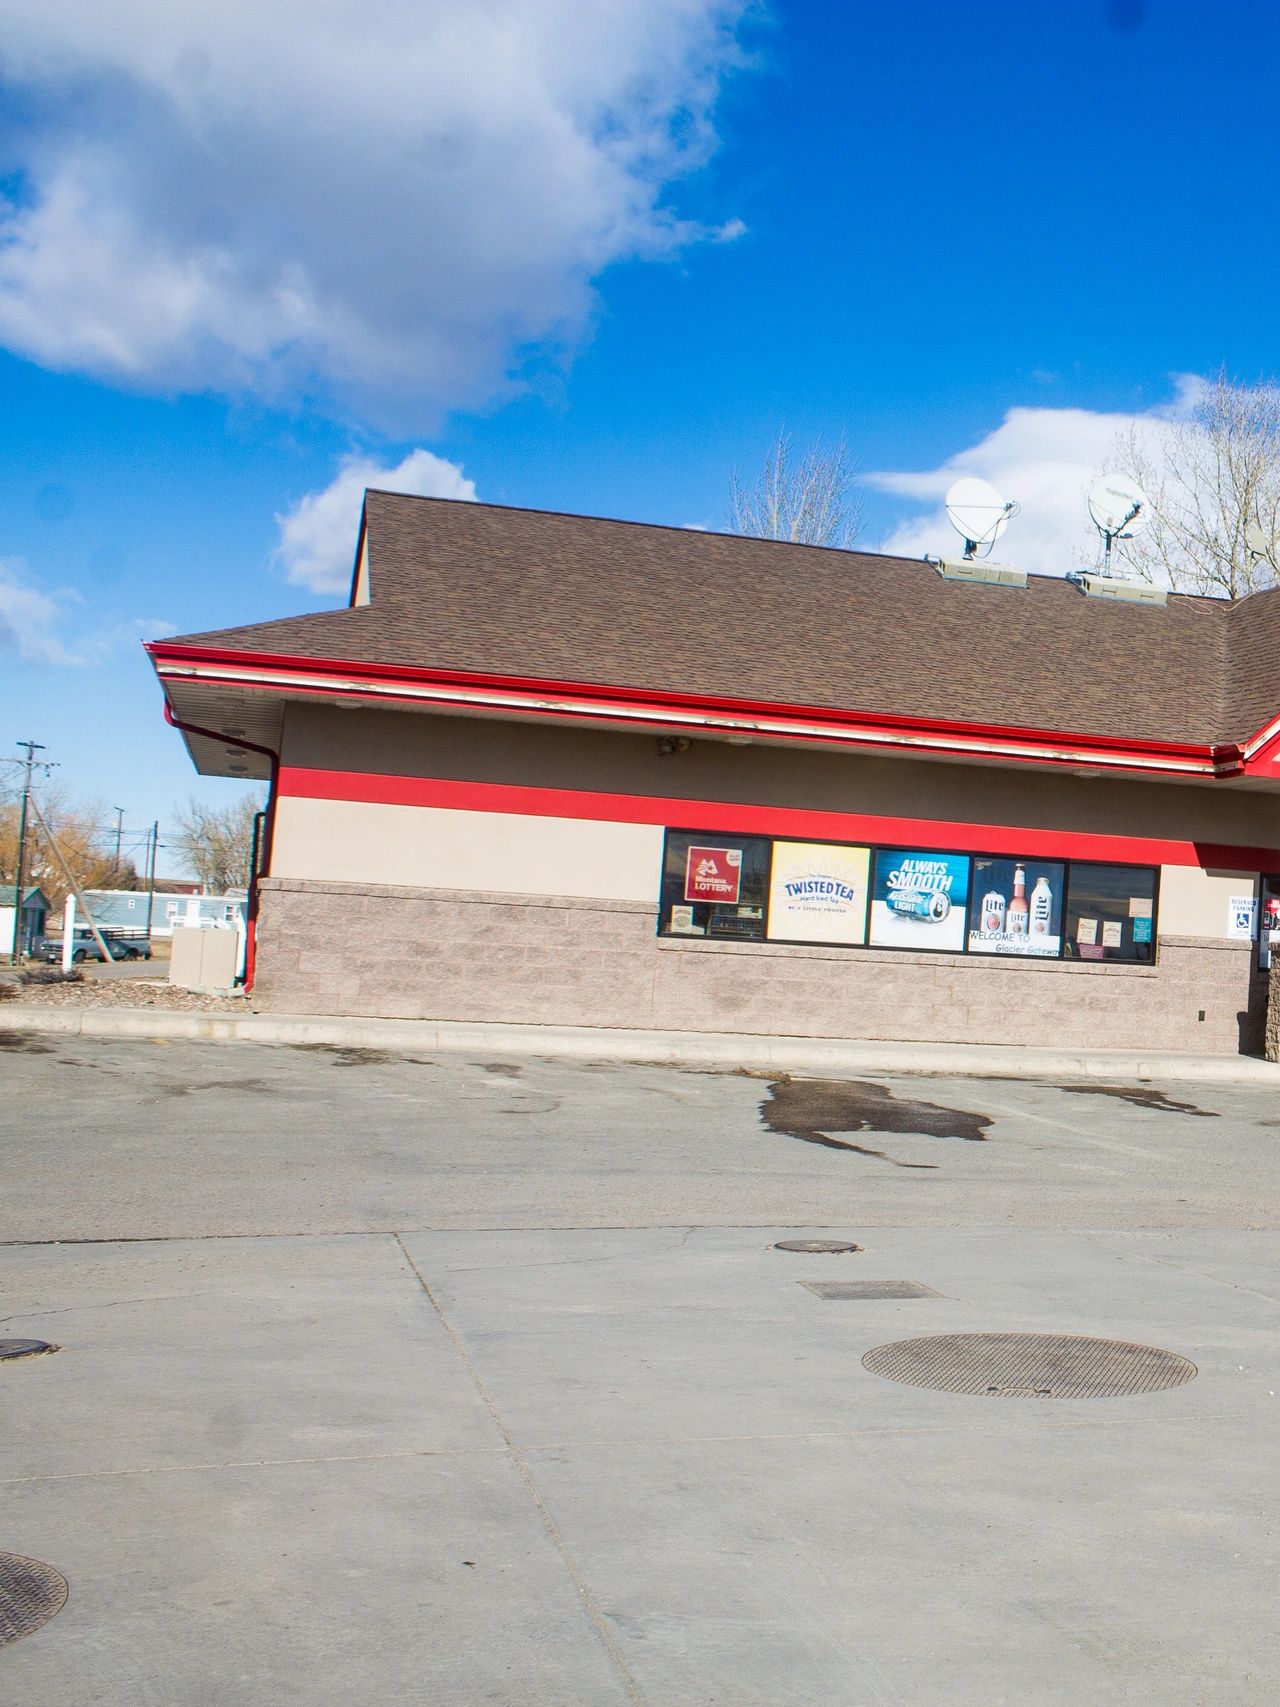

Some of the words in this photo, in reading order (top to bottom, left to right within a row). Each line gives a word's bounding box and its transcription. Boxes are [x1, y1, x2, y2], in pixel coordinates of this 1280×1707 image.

[900, 859, 948, 875] ALWAYS
[695, 875, 727, 884] Montana
[886, 871, 954, 891] SMOOTH
[695, 882, 733, 892] LOTTERY
[784, 880, 834, 897] TWISTED
[835, 882, 854, 902] TEA
[894, 900, 916, 912] LIGHT
[985, 899, 1004, 913] Lite
[1231, 898, 1257, 906] RESERVED
[1034, 896, 1050, 921] Lite
[1232, 905, 1255, 913] PARKING
[1010, 912, 1026, 922] Lite
[969, 930, 1016, 942] WELCOME
[1017, 934, 1031, 943] TO
[995, 943, 1025, 953] Glacier
